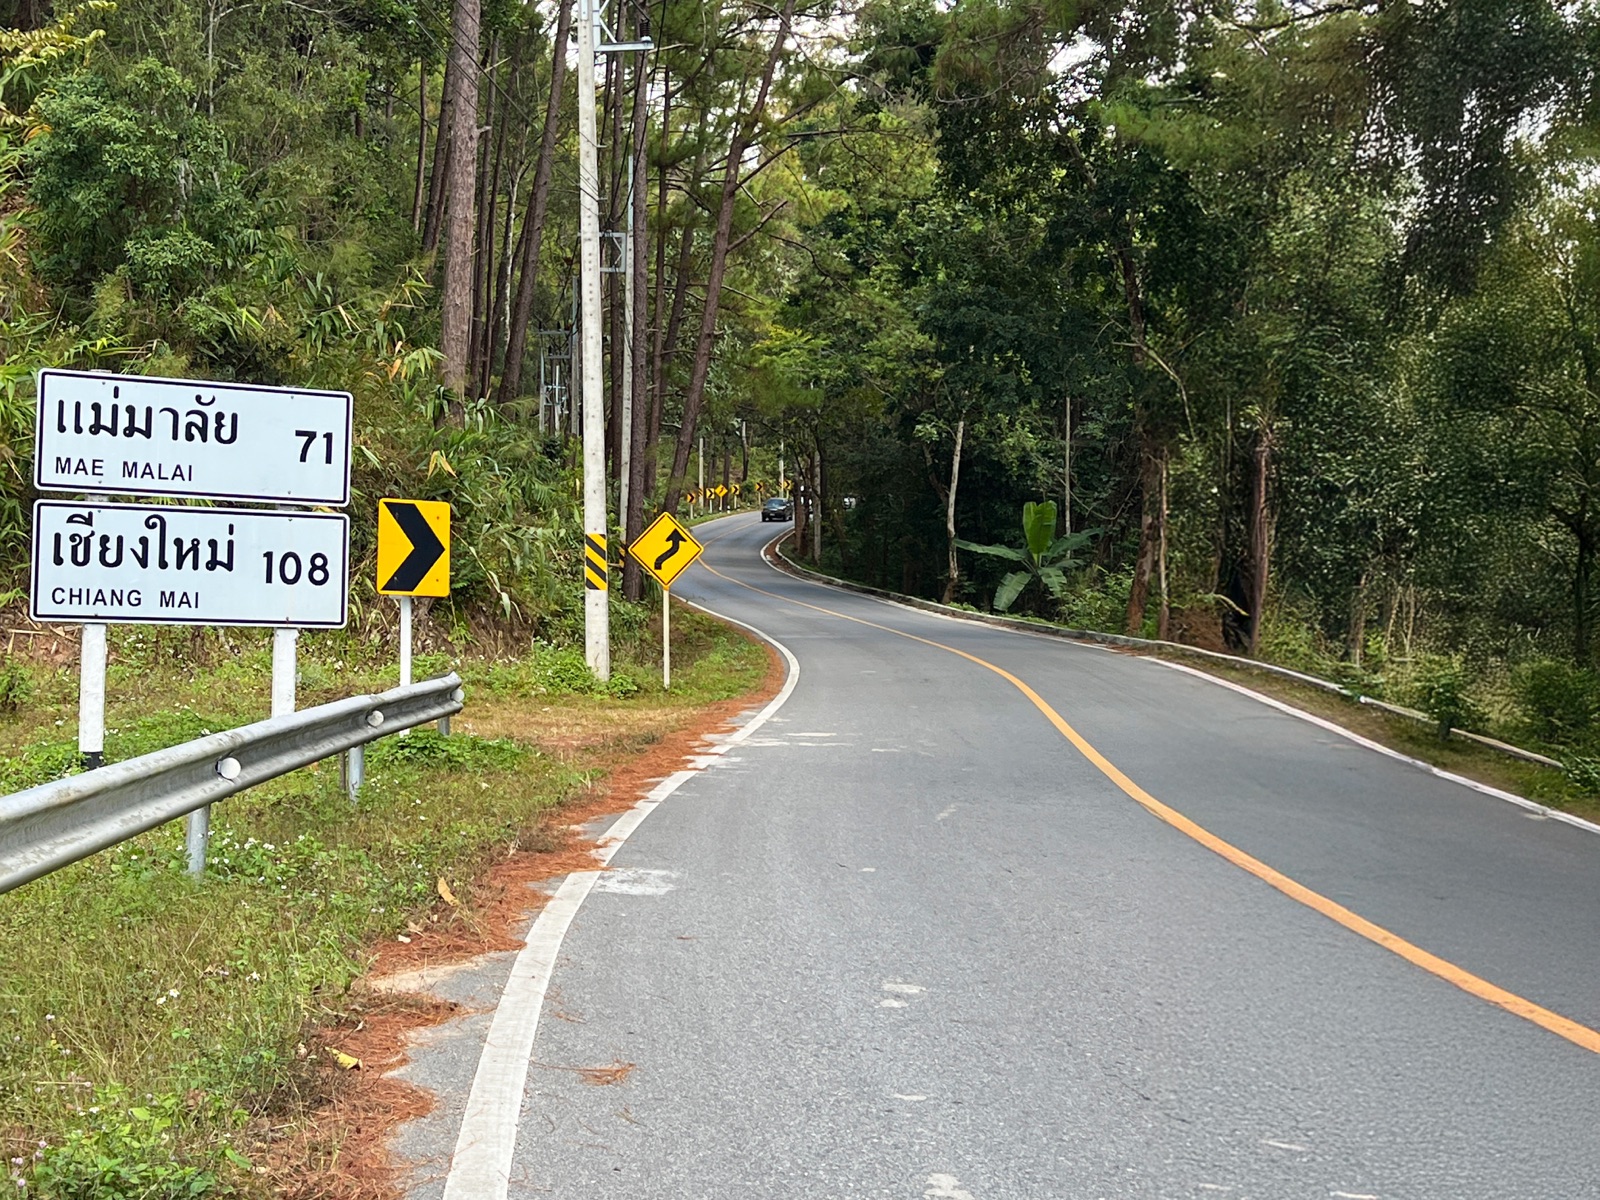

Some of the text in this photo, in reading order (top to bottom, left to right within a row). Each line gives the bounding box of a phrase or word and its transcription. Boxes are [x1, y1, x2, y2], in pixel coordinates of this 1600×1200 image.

[57, 385, 239, 445] แม่มาลัย
[294, 429, 333, 465] 71
[55, 456, 193, 482] MAE MALAI
[52, 510, 235, 573] เชียงใหม่
[262, 550, 330, 587] 108
[51, 587, 199, 609] CHIANG MAI
